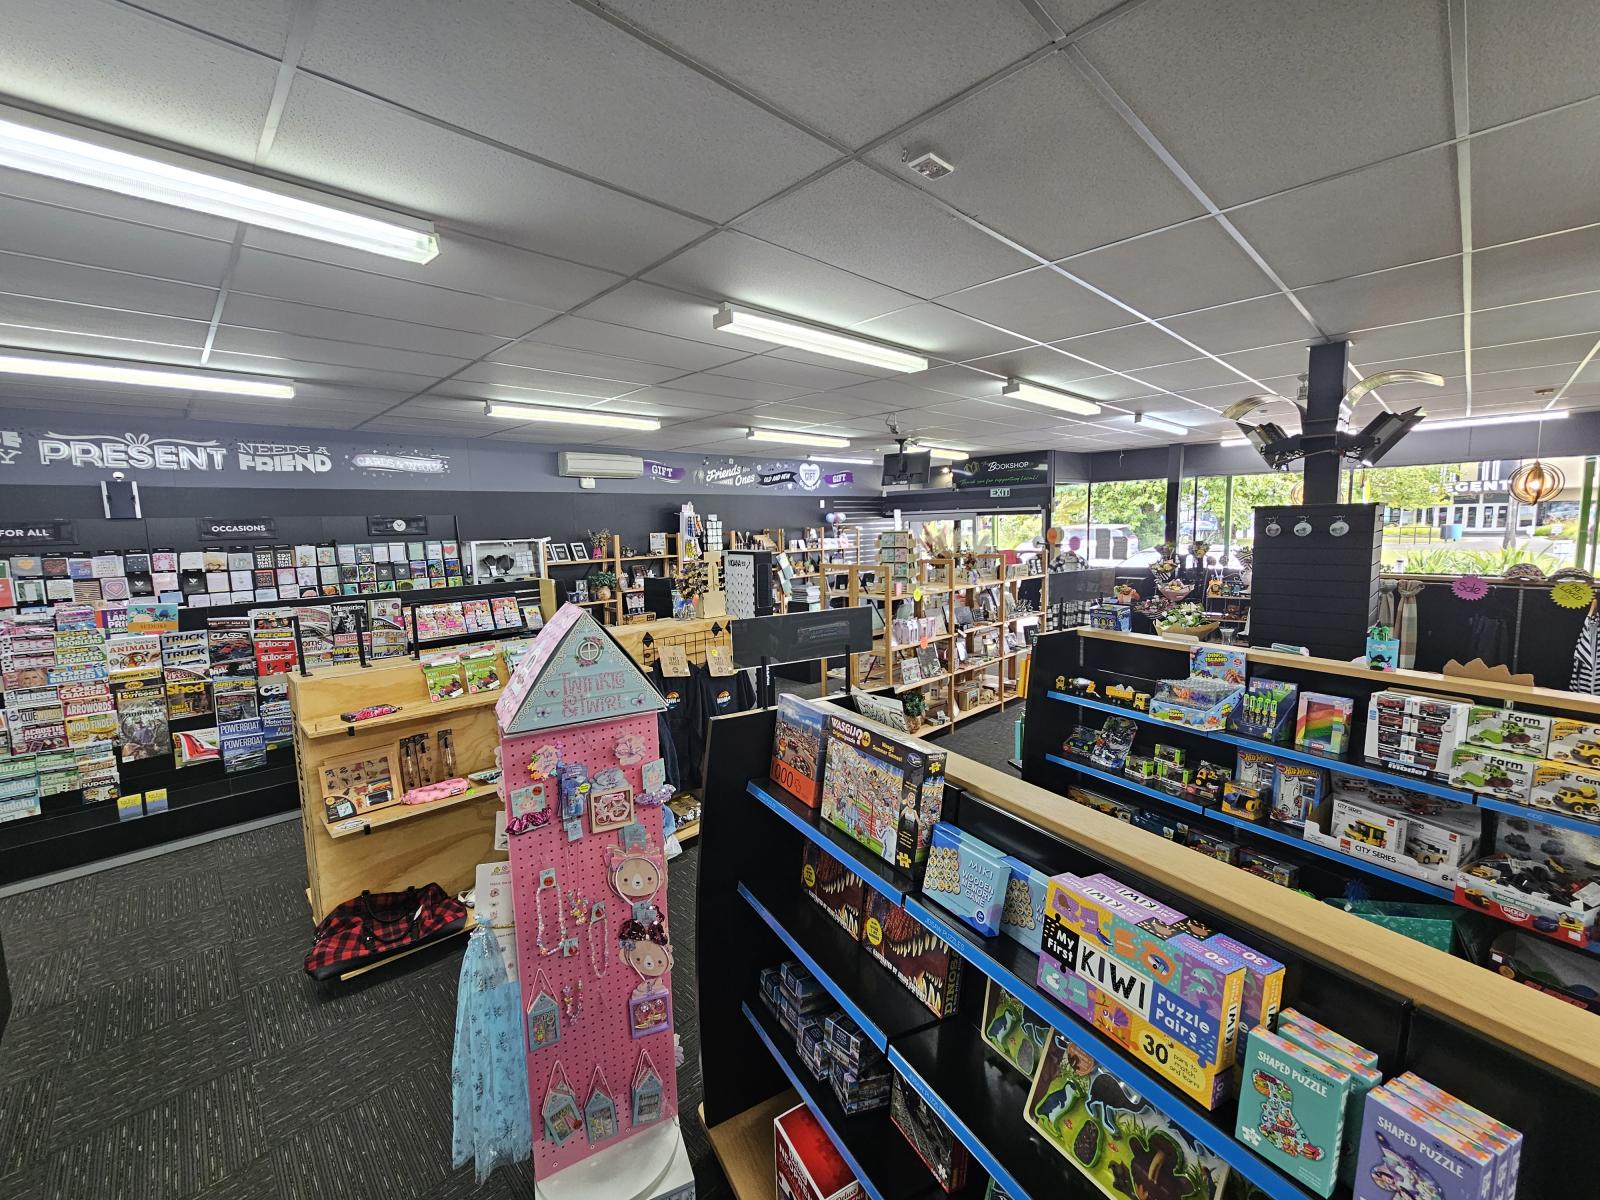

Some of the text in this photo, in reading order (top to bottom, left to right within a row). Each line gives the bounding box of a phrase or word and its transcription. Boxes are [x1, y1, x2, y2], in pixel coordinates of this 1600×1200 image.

[38, 439, 227, 470] PRESENT
[237, 443, 331, 456] NEEDS A
[238, 453, 332, 473] FRIEND
[988, 461, 1029, 472] BOOKSHOP
[651, 465, 673, 478] GIFT
[706, 464, 742, 482] Friends
[832, 474, 846, 483] GIFT
[734, 474, 755, 487] Ones
[991, 488, 1008, 497] EXIT
[211, 525, 266, 533] OCCASIONS
[1457, 582, 1480, 595] Sale
[164, 634, 205, 643] TRUCK
[211, 632, 248, 640] CLASSIC
[110, 643, 157, 654] ANIMALS
[165, 648, 206, 659] TRUCK
[260, 653, 293, 661] autocar
[122, 690, 160, 699] OUTDOOR
[166, 683, 206, 695] Shed
[66, 702, 112, 716] ARROWORDS
[1507, 713, 1541, 726] Farm
[220, 721, 260, 735] POWERBOAT
[224, 736, 264, 750] POWERBOAT
[0, 761, 35, 772] uzzles
[1388, 762, 1428, 777] model
[1490, 756, 1523, 770] Farm
[82, 779, 117, 788] SUDOKU
[1337, 802, 1347, 810] CITY
[1355, 844, 1397, 864] CITY SERIES
[968, 861, 994, 880] MIKI
[962, 870, 994, 896] WOODEN
[1441, 874, 1455, 883] 6+
[961, 881, 993, 903] MEMORY
[1080, 887, 1127, 908] KIWI
[1116, 887, 1158, 910] KIWI
[965, 890, 986, 909] GAME
[1056, 930, 1075, 949] My
[1046, 940, 1074, 963] First
[1079, 943, 1147, 1011] KIWI
[1157, 991, 1211, 1035] Puzzle
[1155, 1007, 1198, 1045] Pairs
[1225, 1004, 1238, 1046] KIWI
[1142, 1033, 1169, 1066] 30
[1173, 1053, 1198, 1073] pairs to
[1174, 1061, 1196, 1079] match
[1169, 1065, 1183, 1079] and
[1257, 1050, 1291, 1076] SHAPED
[1290, 1069, 1329, 1099] PUZZLE
[1377, 1116, 1418, 1149] SHAPED
[1419, 1140, 1465, 1180] PUZZLE
